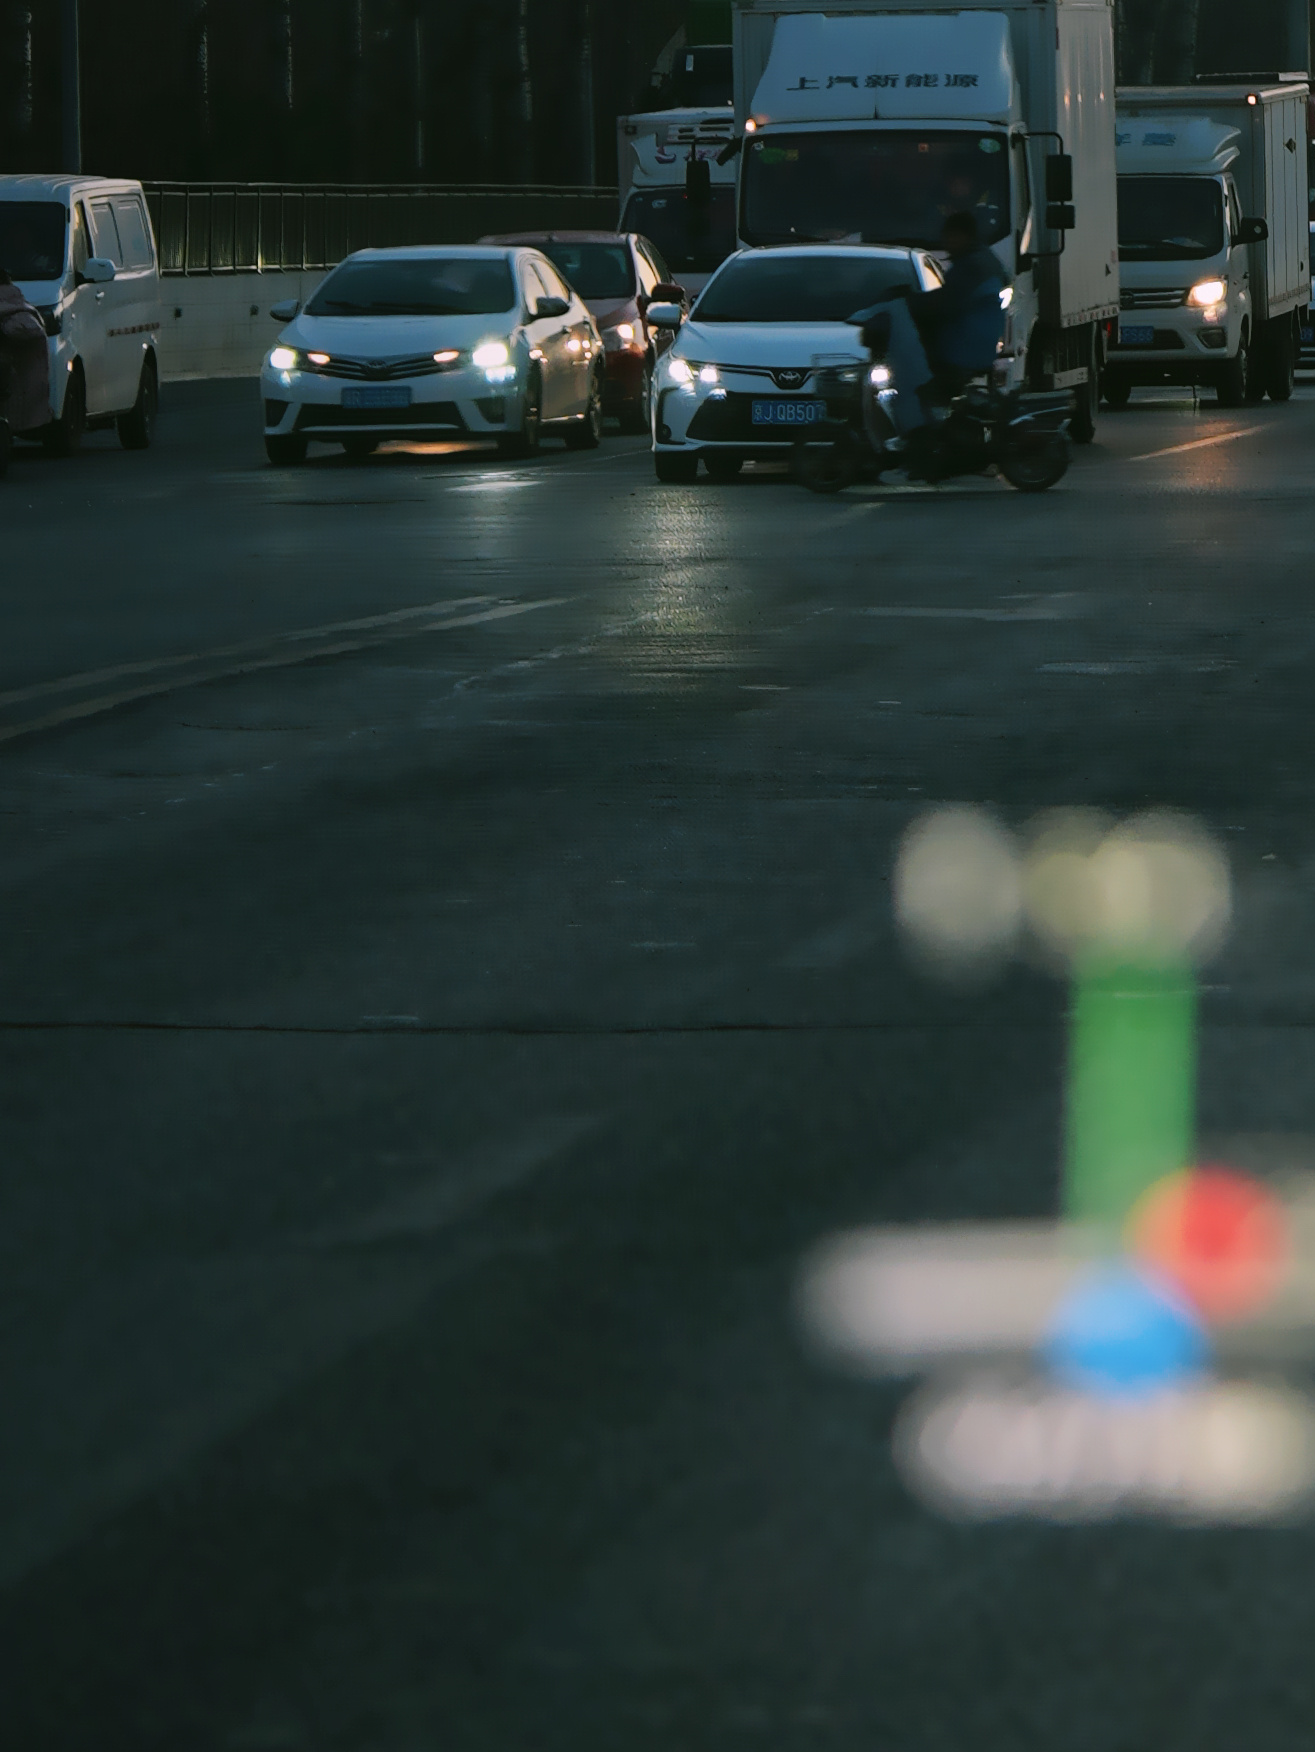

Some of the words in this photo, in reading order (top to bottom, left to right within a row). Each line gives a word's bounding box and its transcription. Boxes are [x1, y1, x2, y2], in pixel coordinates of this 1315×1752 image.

[785, 73, 980, 91] 上汽新能源
